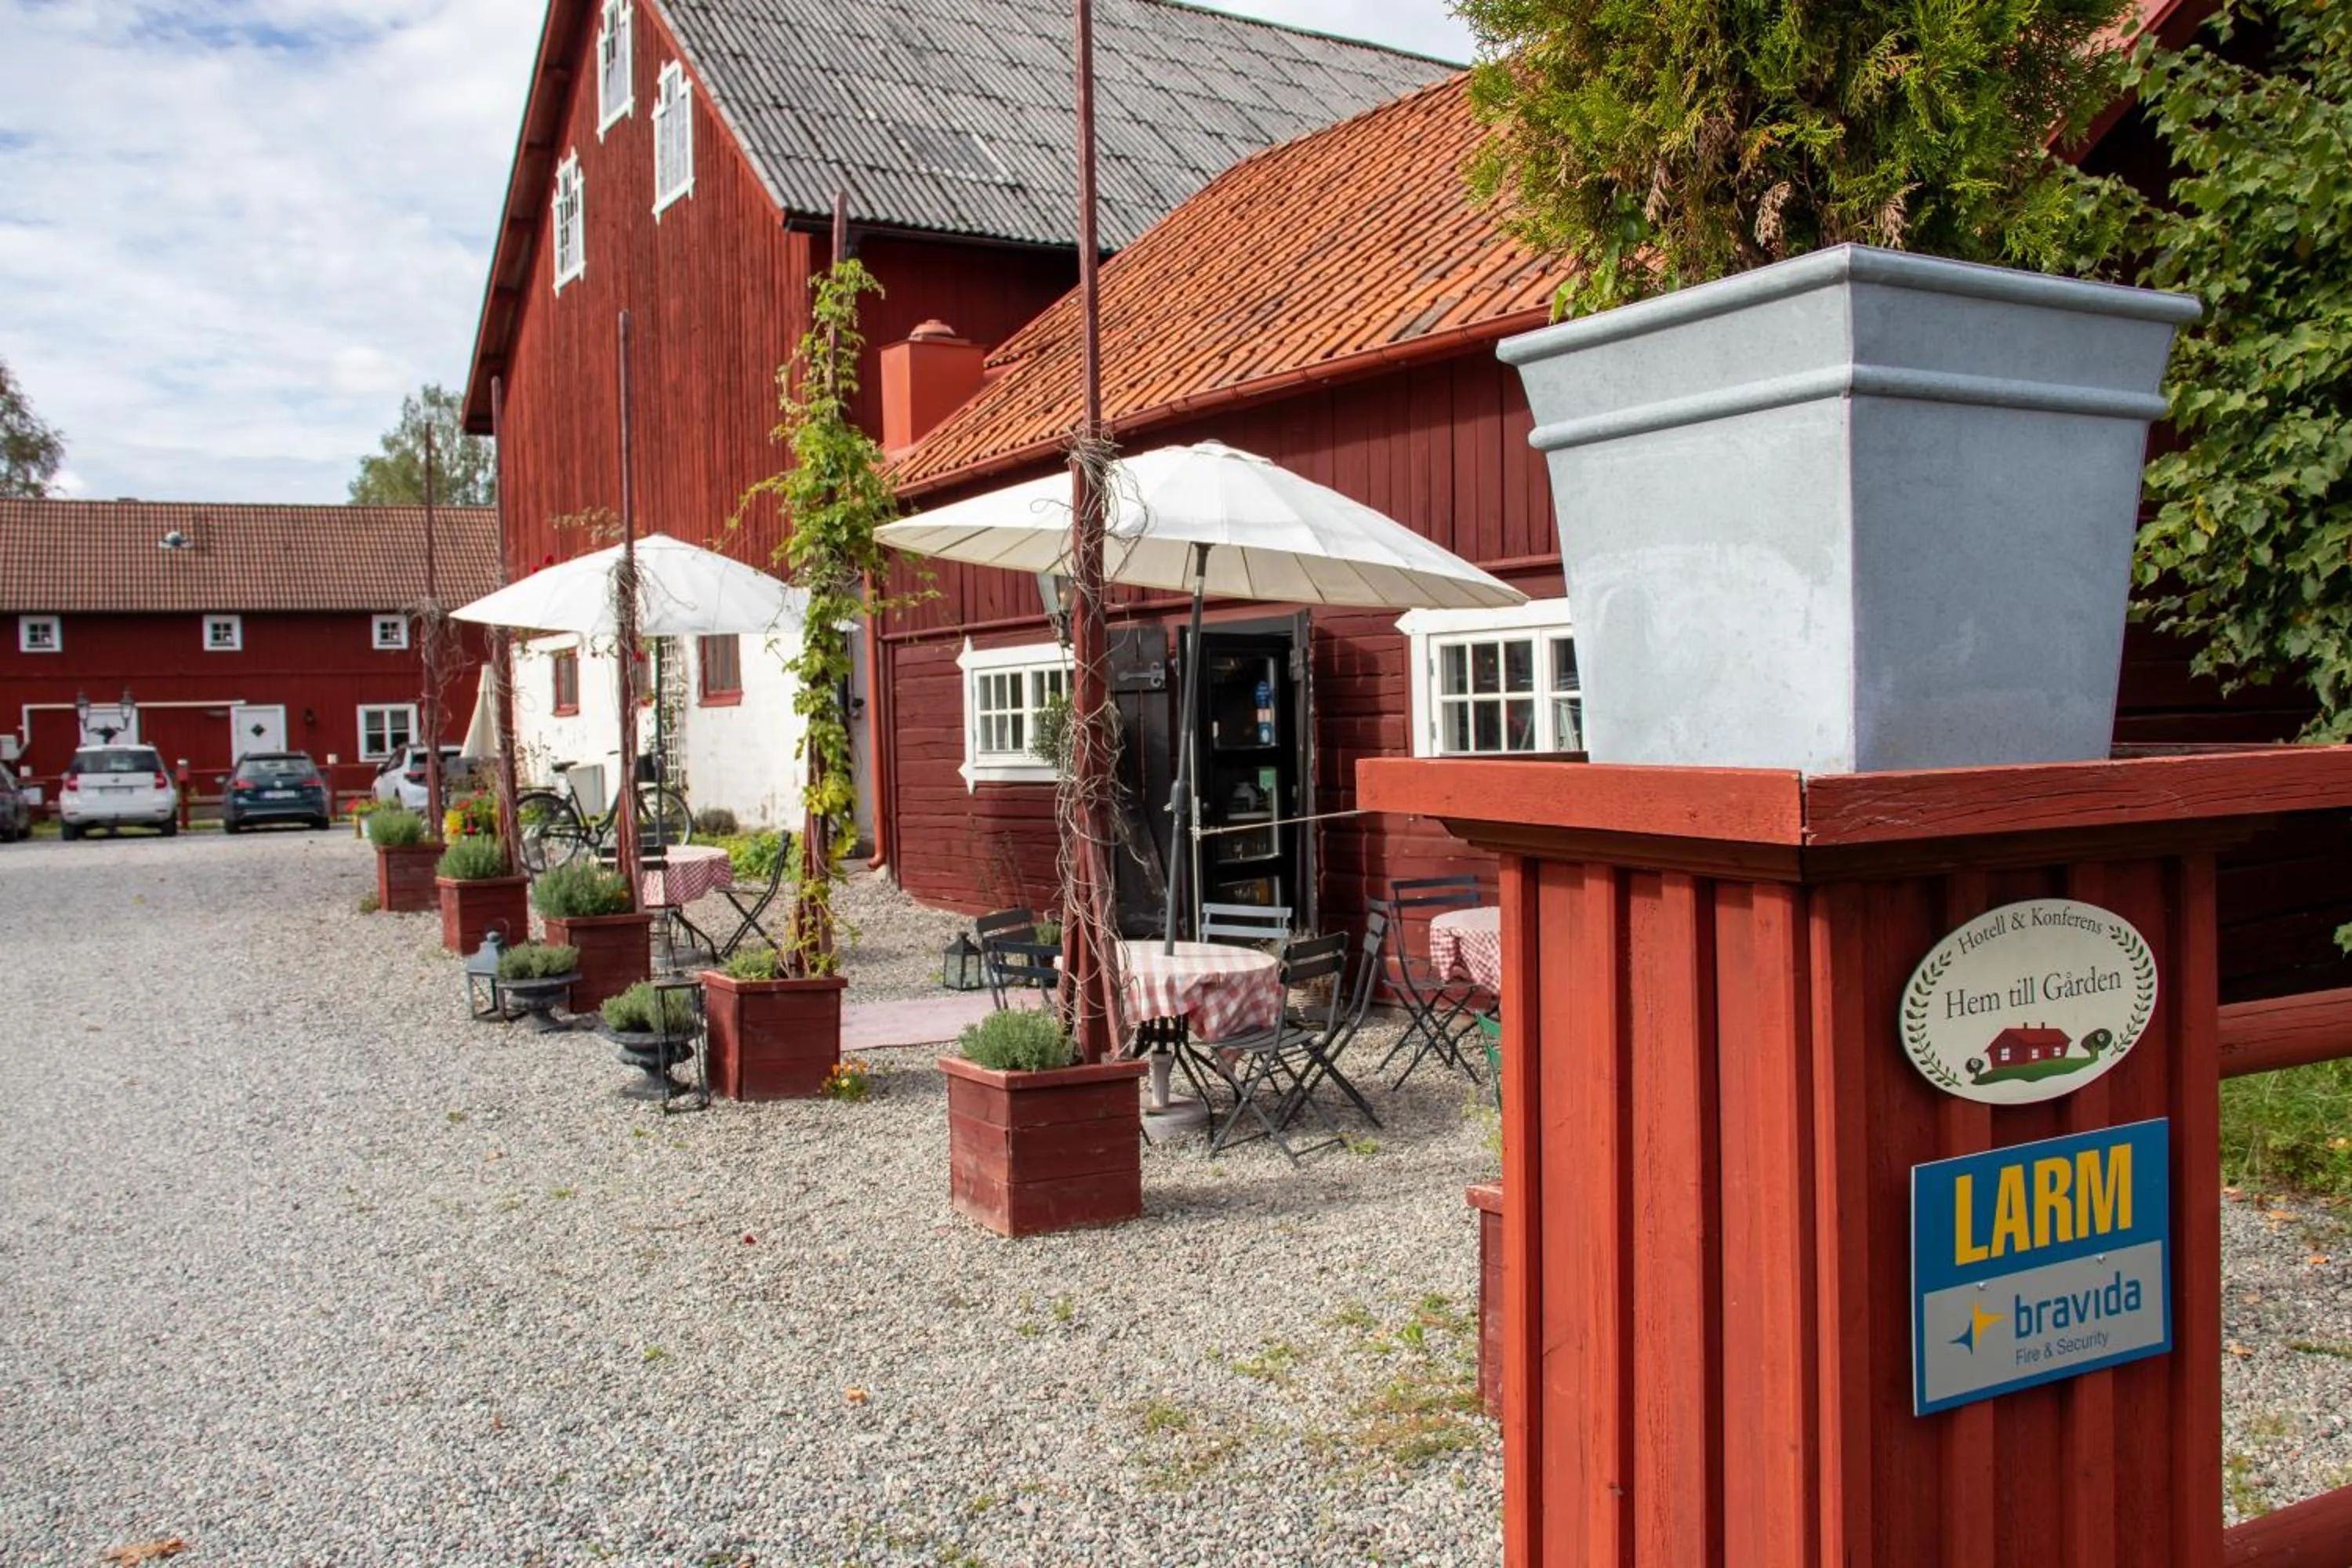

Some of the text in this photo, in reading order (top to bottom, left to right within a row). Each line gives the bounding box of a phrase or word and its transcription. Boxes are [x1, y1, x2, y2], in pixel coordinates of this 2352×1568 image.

[1958, 907, 2103, 955] Hotell & Konferens
[1944, 965, 2122, 1019] Hem till Gården
[1955, 1143, 2132, 1266] LARM
[2015, 1271, 2141, 1339] bravida
[2016, 1330, 2108, 1366] Fire & Security
